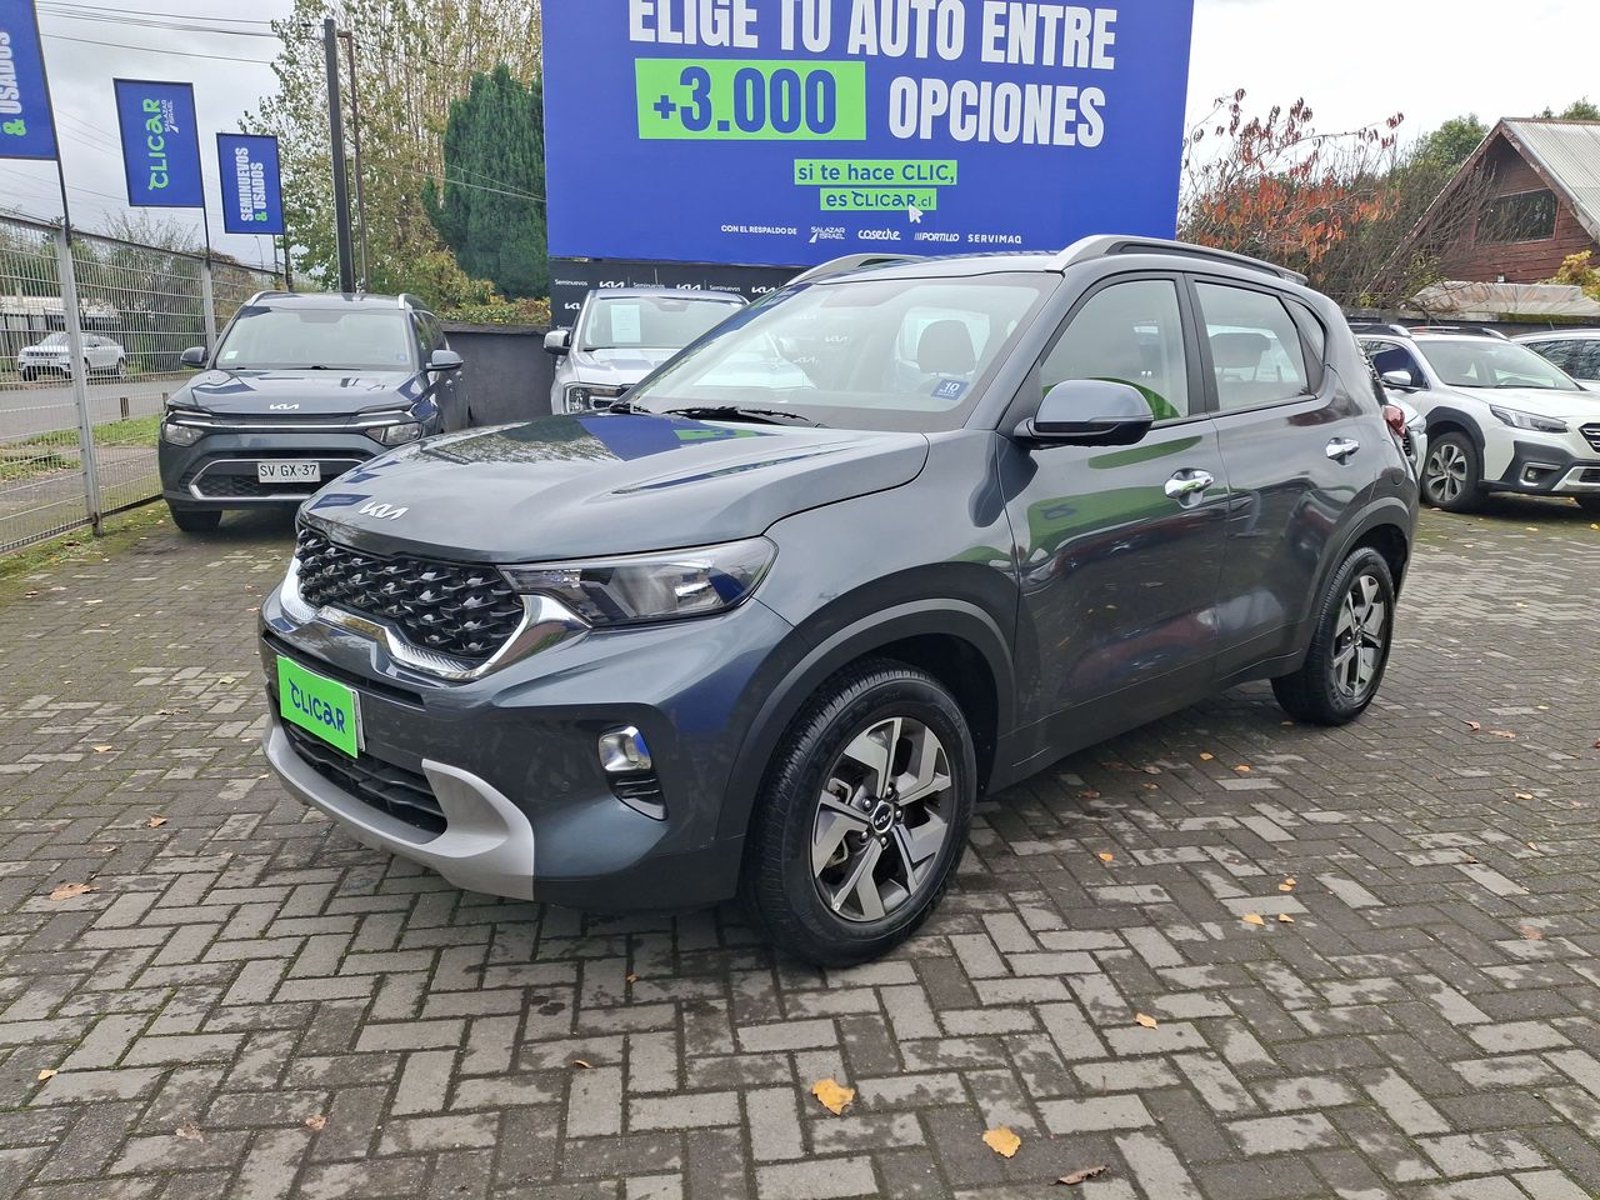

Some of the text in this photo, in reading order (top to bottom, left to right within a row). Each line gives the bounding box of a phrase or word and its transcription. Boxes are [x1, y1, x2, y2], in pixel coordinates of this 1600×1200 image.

[629, 0, 1118, 70] ELIGE TU AUTO ENTRE
[653, 65, 1106, 148] +3.000 OPCIONES
[2, 118, 27, 136] &
[798, 163, 955, 184] si te hace CLIC,
[235, 147, 254, 222] SEMINUEVOS
[250, 162, 268, 222] & USADOS
[825, 194, 848, 207] es
[749, 226, 787, 235] RESPALDO
[811, 226, 845, 234] SALAZAR
[967, 234, 1022, 244] SERVIMAQ
[555, 279, 588, 287] Seminuevos
[599, 280, 625, 289] KIA
[751, 286, 776, 294] KIA
[564, 302, 581, 310] KI
[260, 464, 317, 477] SV GX 37
[358, 500, 409, 521] KIA
